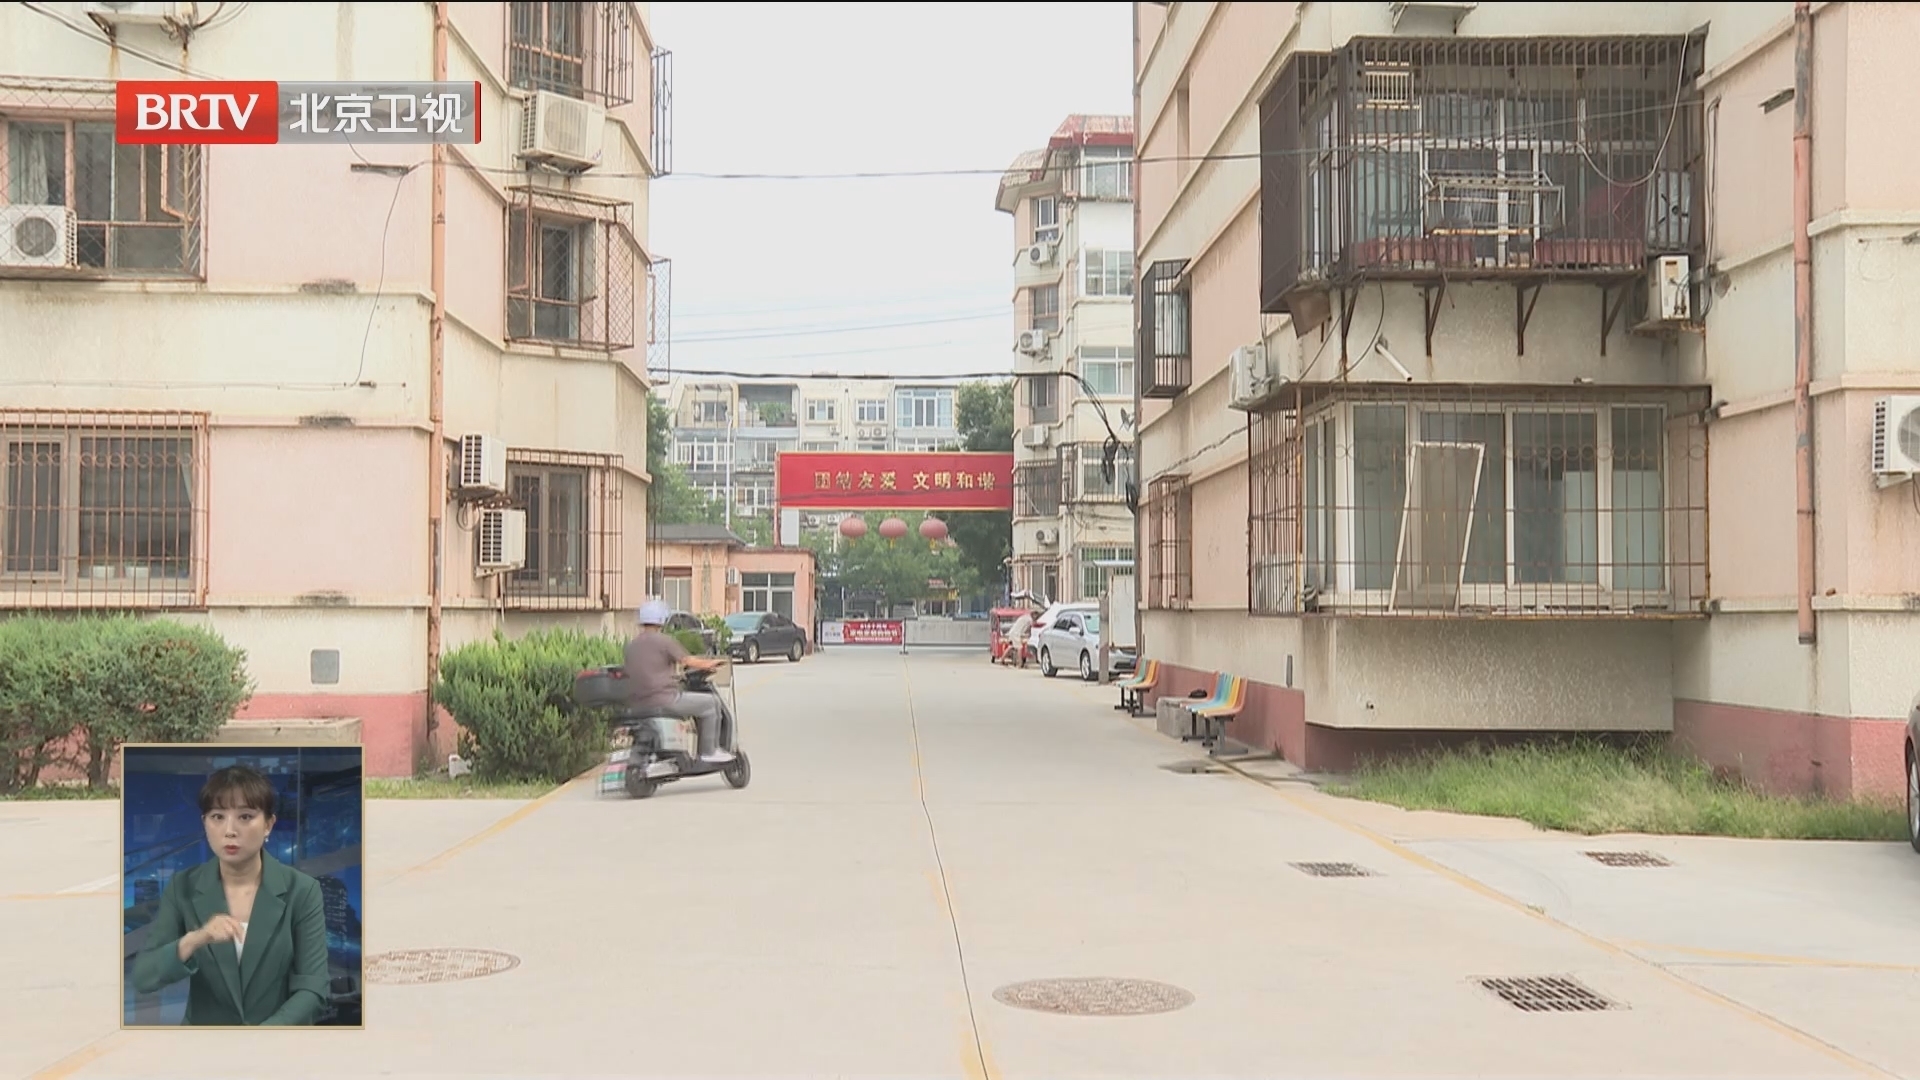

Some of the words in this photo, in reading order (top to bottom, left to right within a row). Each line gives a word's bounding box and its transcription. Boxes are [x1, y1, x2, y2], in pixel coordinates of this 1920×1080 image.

[814, 470, 897, 491] 团结友爱
[912, 470, 996, 492] 文明和谐
